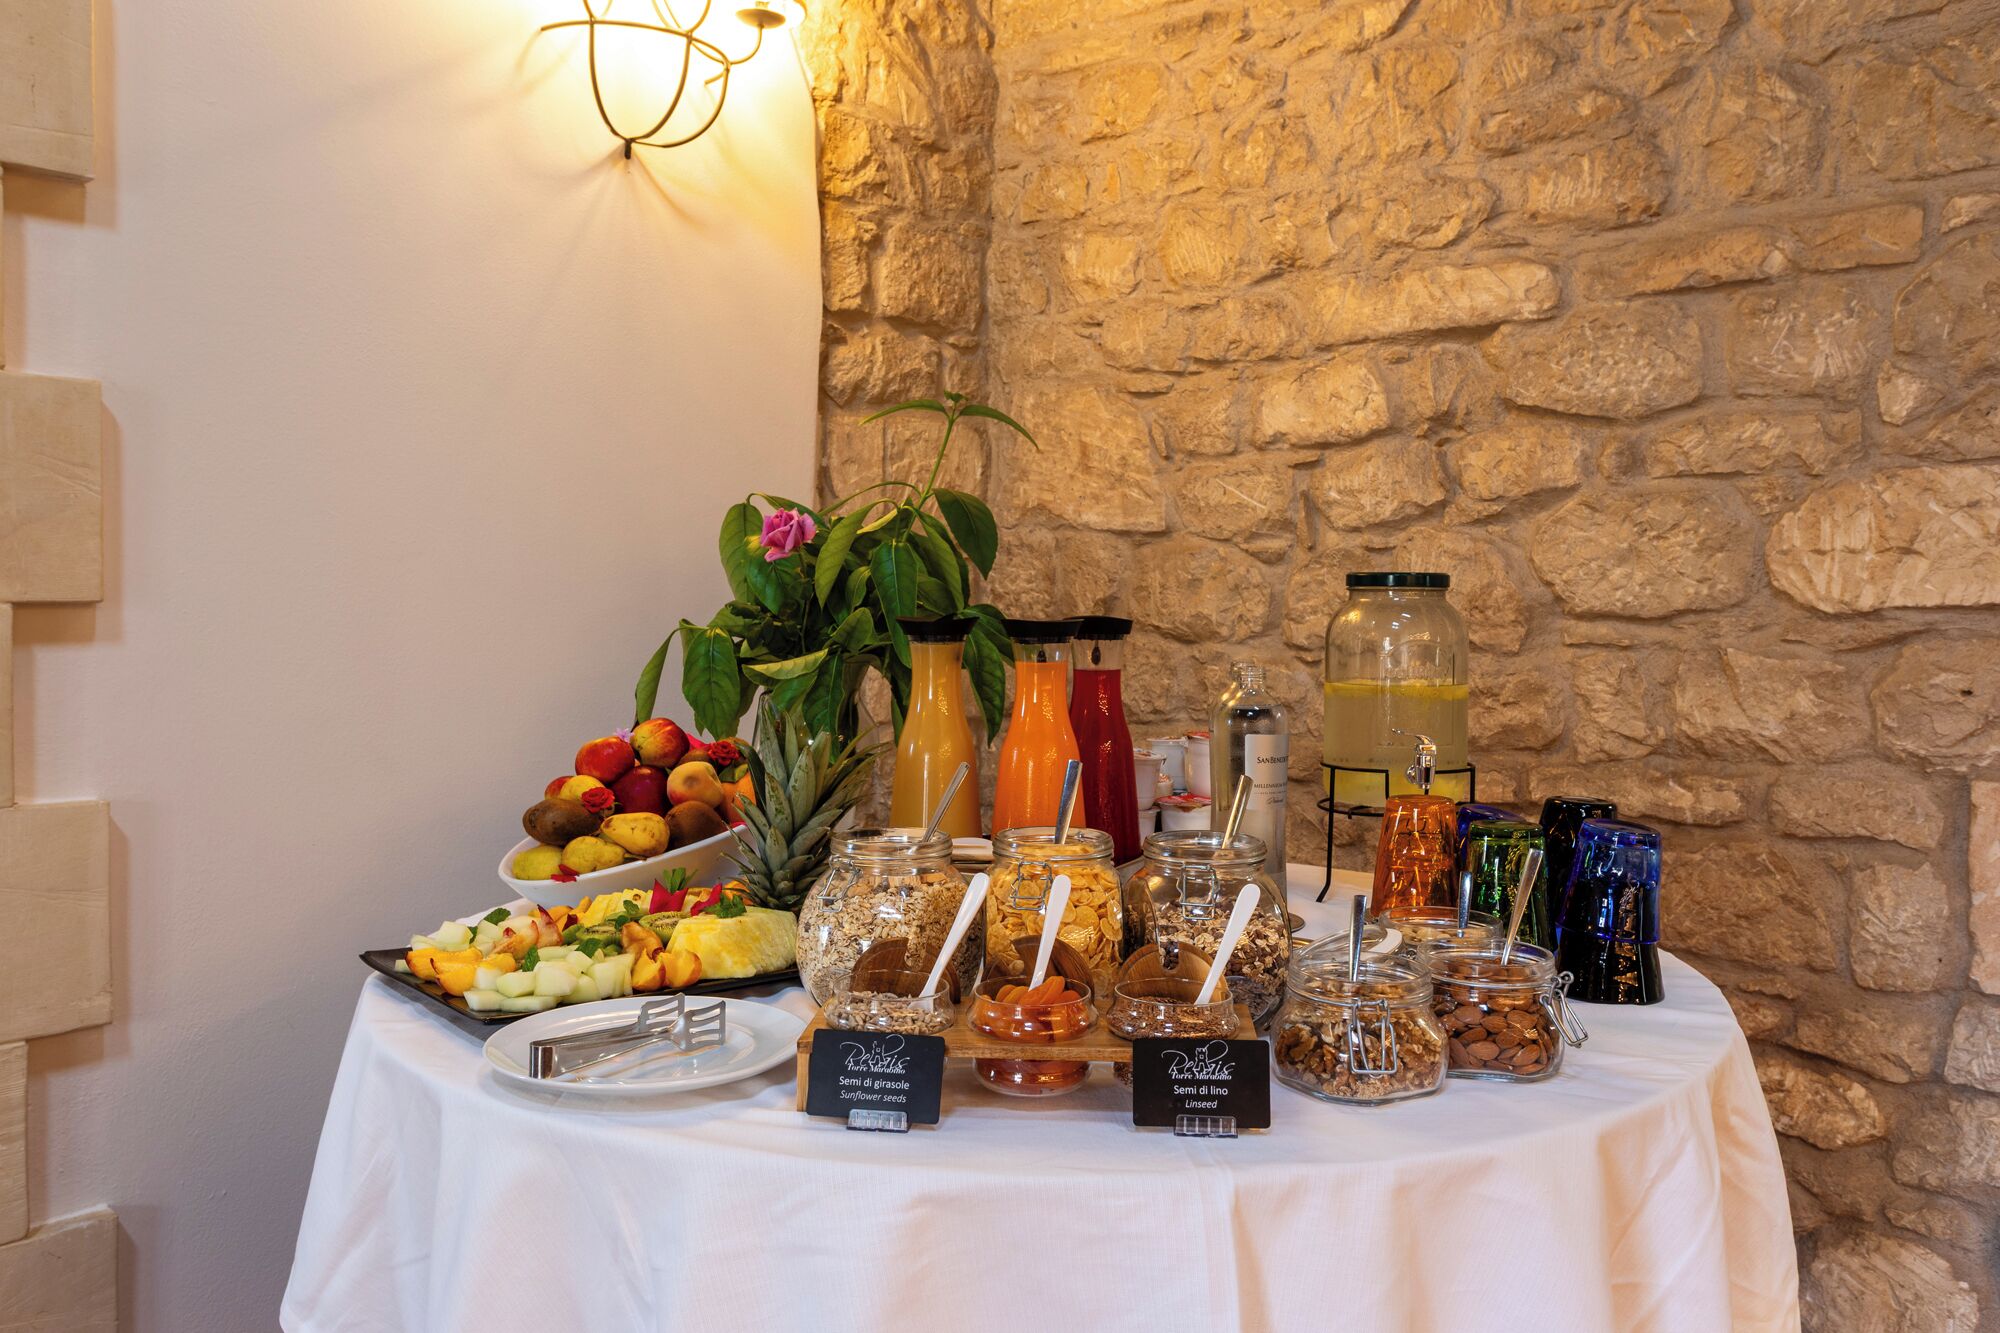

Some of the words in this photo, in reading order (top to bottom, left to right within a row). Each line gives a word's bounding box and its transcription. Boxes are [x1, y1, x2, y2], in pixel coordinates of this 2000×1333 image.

[847, 1063, 868, 1072] Torre
[1171, 1072, 1193, 1080] Torre
[839, 1076, 861, 1087] Semi
[864, 1077, 872, 1087] di
[874, 1079, 910, 1090] girasole
[1173, 1085, 1197, 1095] Semi
[1199, 1086, 1208, 1095] di
[1210, 1086, 1228, 1095] lino
[840, 1090, 881, 1101] Sunflower
[883, 1094, 907, 1103] seeds
[1185, 1100, 1217, 1109] Linseed
